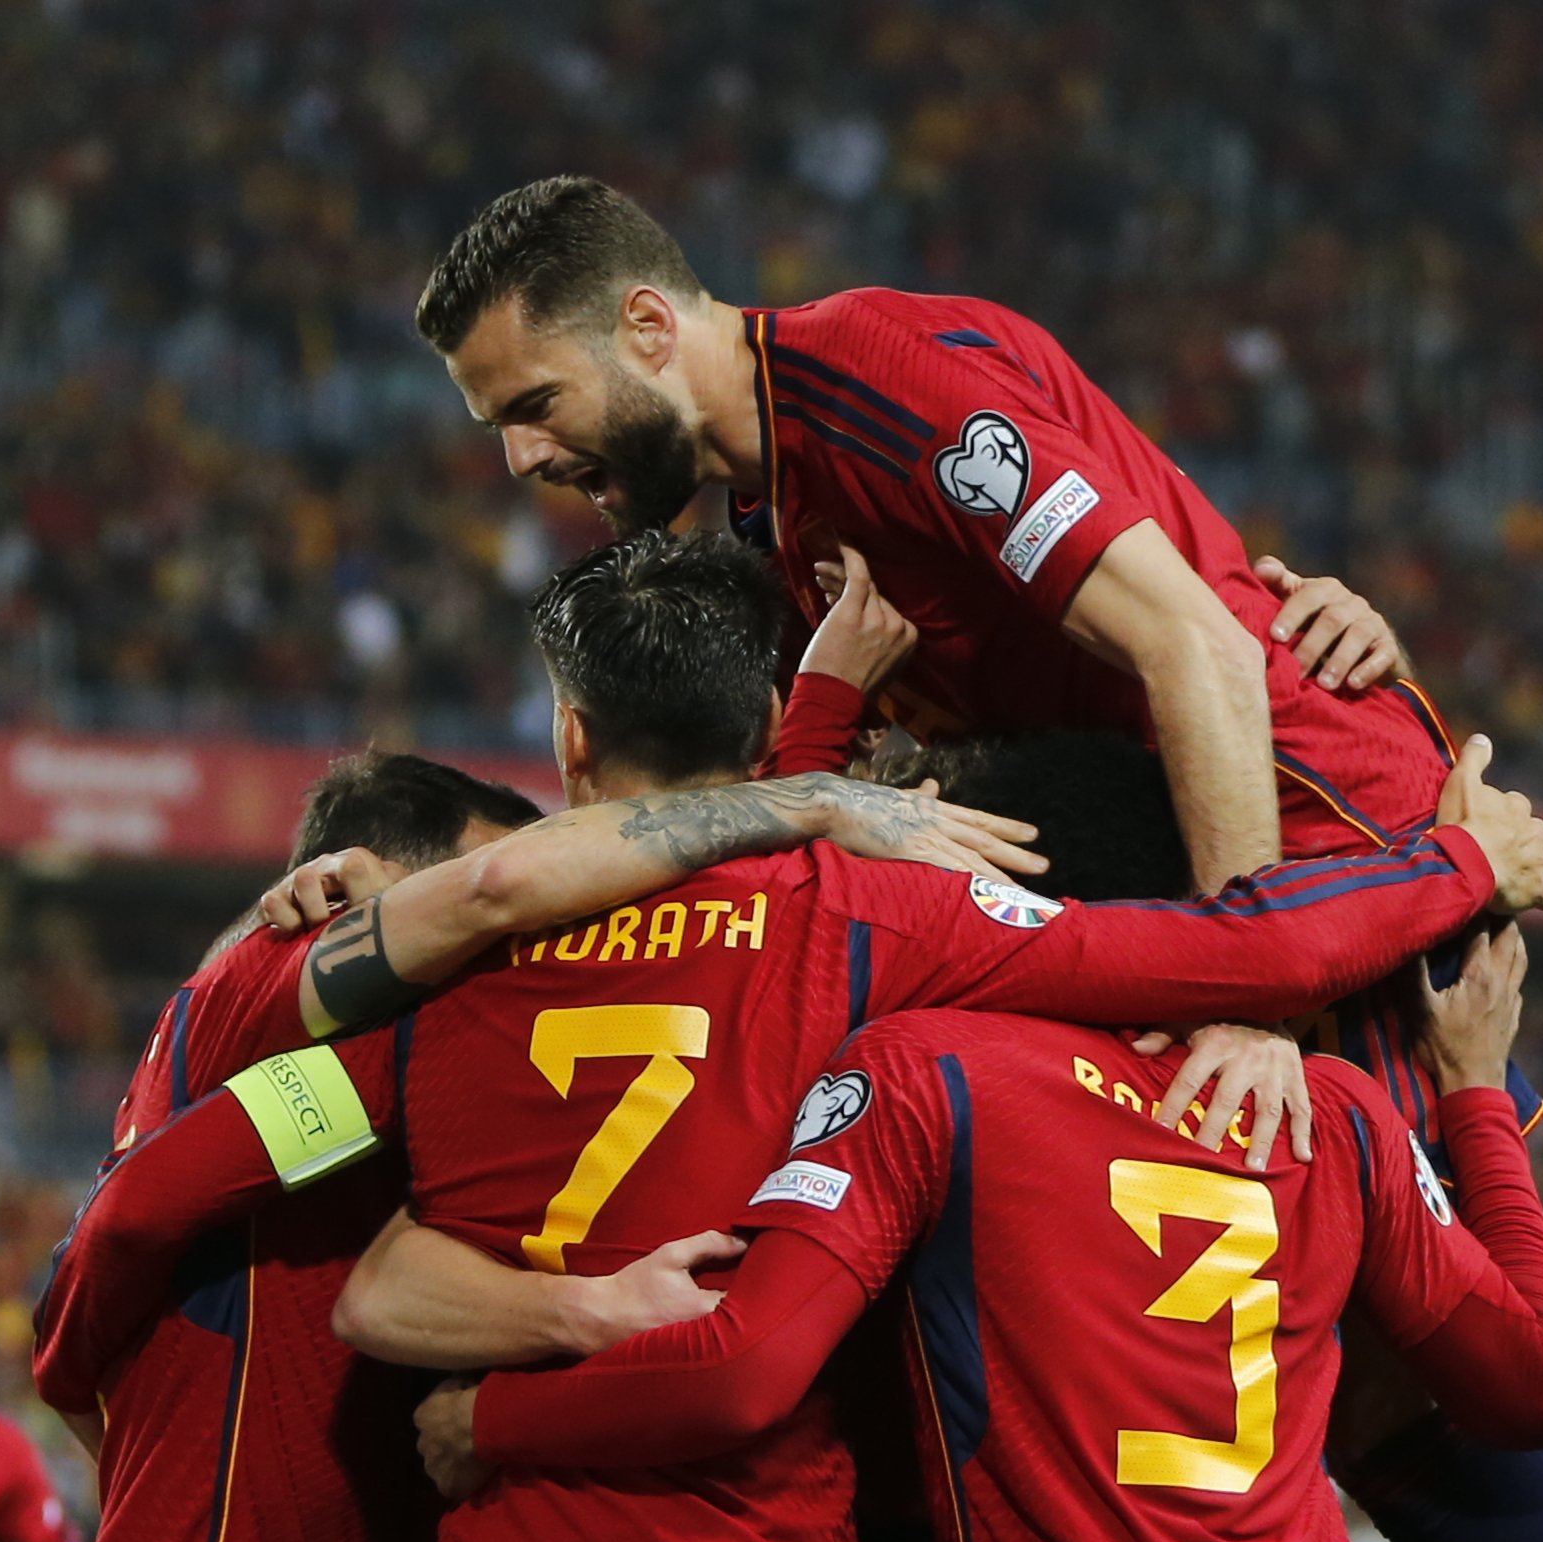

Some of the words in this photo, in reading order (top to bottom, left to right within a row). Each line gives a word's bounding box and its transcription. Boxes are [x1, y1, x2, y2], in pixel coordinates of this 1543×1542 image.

[266, 1056, 326, 1137] RESPECT
[520, 1004, 711, 1275] 7
[1108, 1158, 1280, 1494] 3
